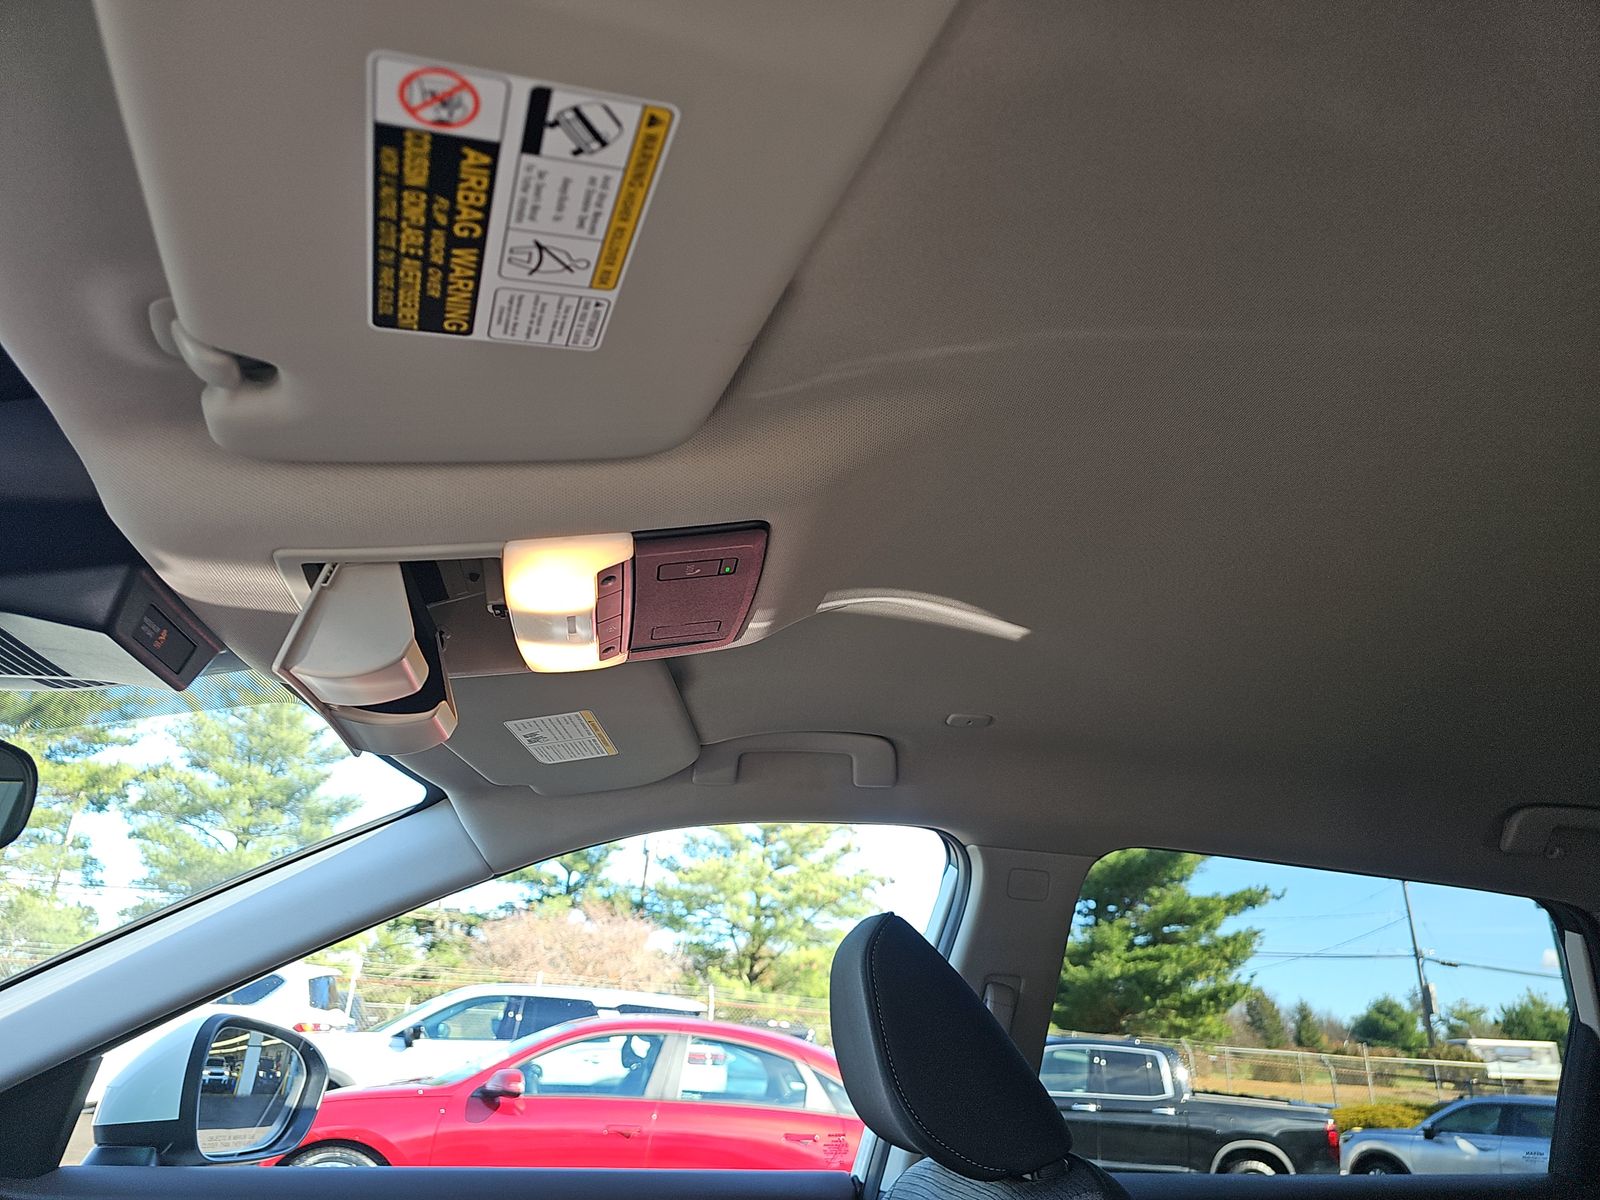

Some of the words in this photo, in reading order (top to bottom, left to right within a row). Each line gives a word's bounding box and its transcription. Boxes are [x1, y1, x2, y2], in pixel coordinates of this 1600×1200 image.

[452, 146, 494, 240] AIRBAG
[428, 228, 447, 265] VISOR
[425, 267, 443, 299] OVER
[442, 246, 480, 332] WARNING
